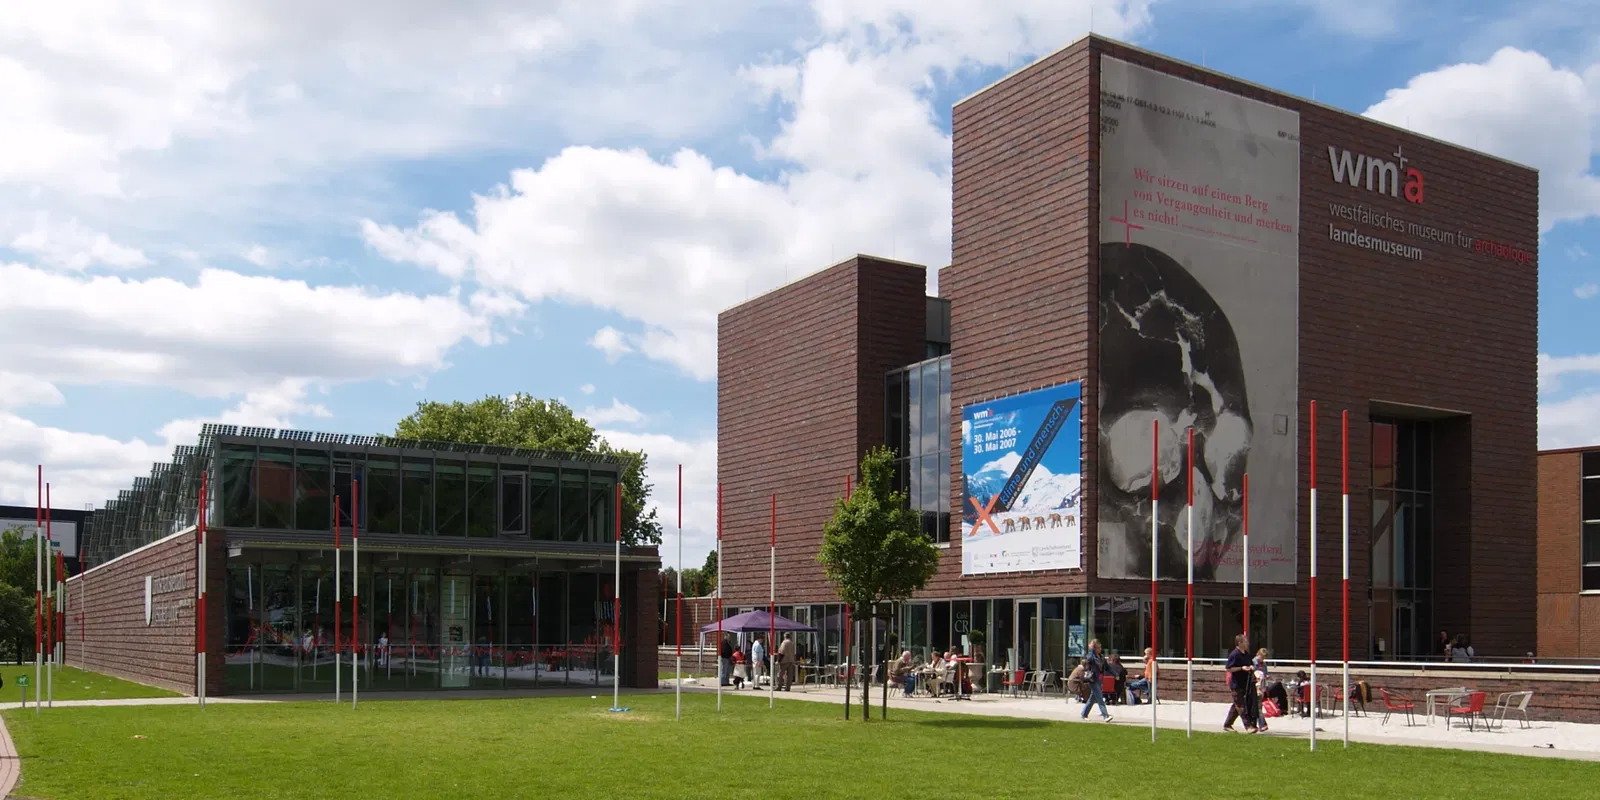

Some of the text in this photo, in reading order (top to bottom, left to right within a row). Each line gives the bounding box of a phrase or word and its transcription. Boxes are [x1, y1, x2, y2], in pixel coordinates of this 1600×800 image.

[1133, 167, 1269, 214] Wir sitzen auf einem Berg
[1133, 188, 1153, 202] von
[1156, 191, 1232, 220] Vergangenheit
[1234, 213, 1253, 225] und
[1256, 218, 1292, 234] merken
[1133, 208, 1178, 228] es nicht!
[1329, 202, 1405, 233] westfälisches
[1408, 220, 1455, 245] museum
[1457, 230, 1473, 250] für
[1329, 223, 1423, 262] landesmuseum
[973, 434, 984, 445] 30.
[985, 430, 998, 443] Mai
[999, 427, 1017, 440] 2006
[973, 437, 1017, 456] 30. Mai 2007
[999, 473, 1021, 504] klima
[1019, 447, 1036, 473] und
